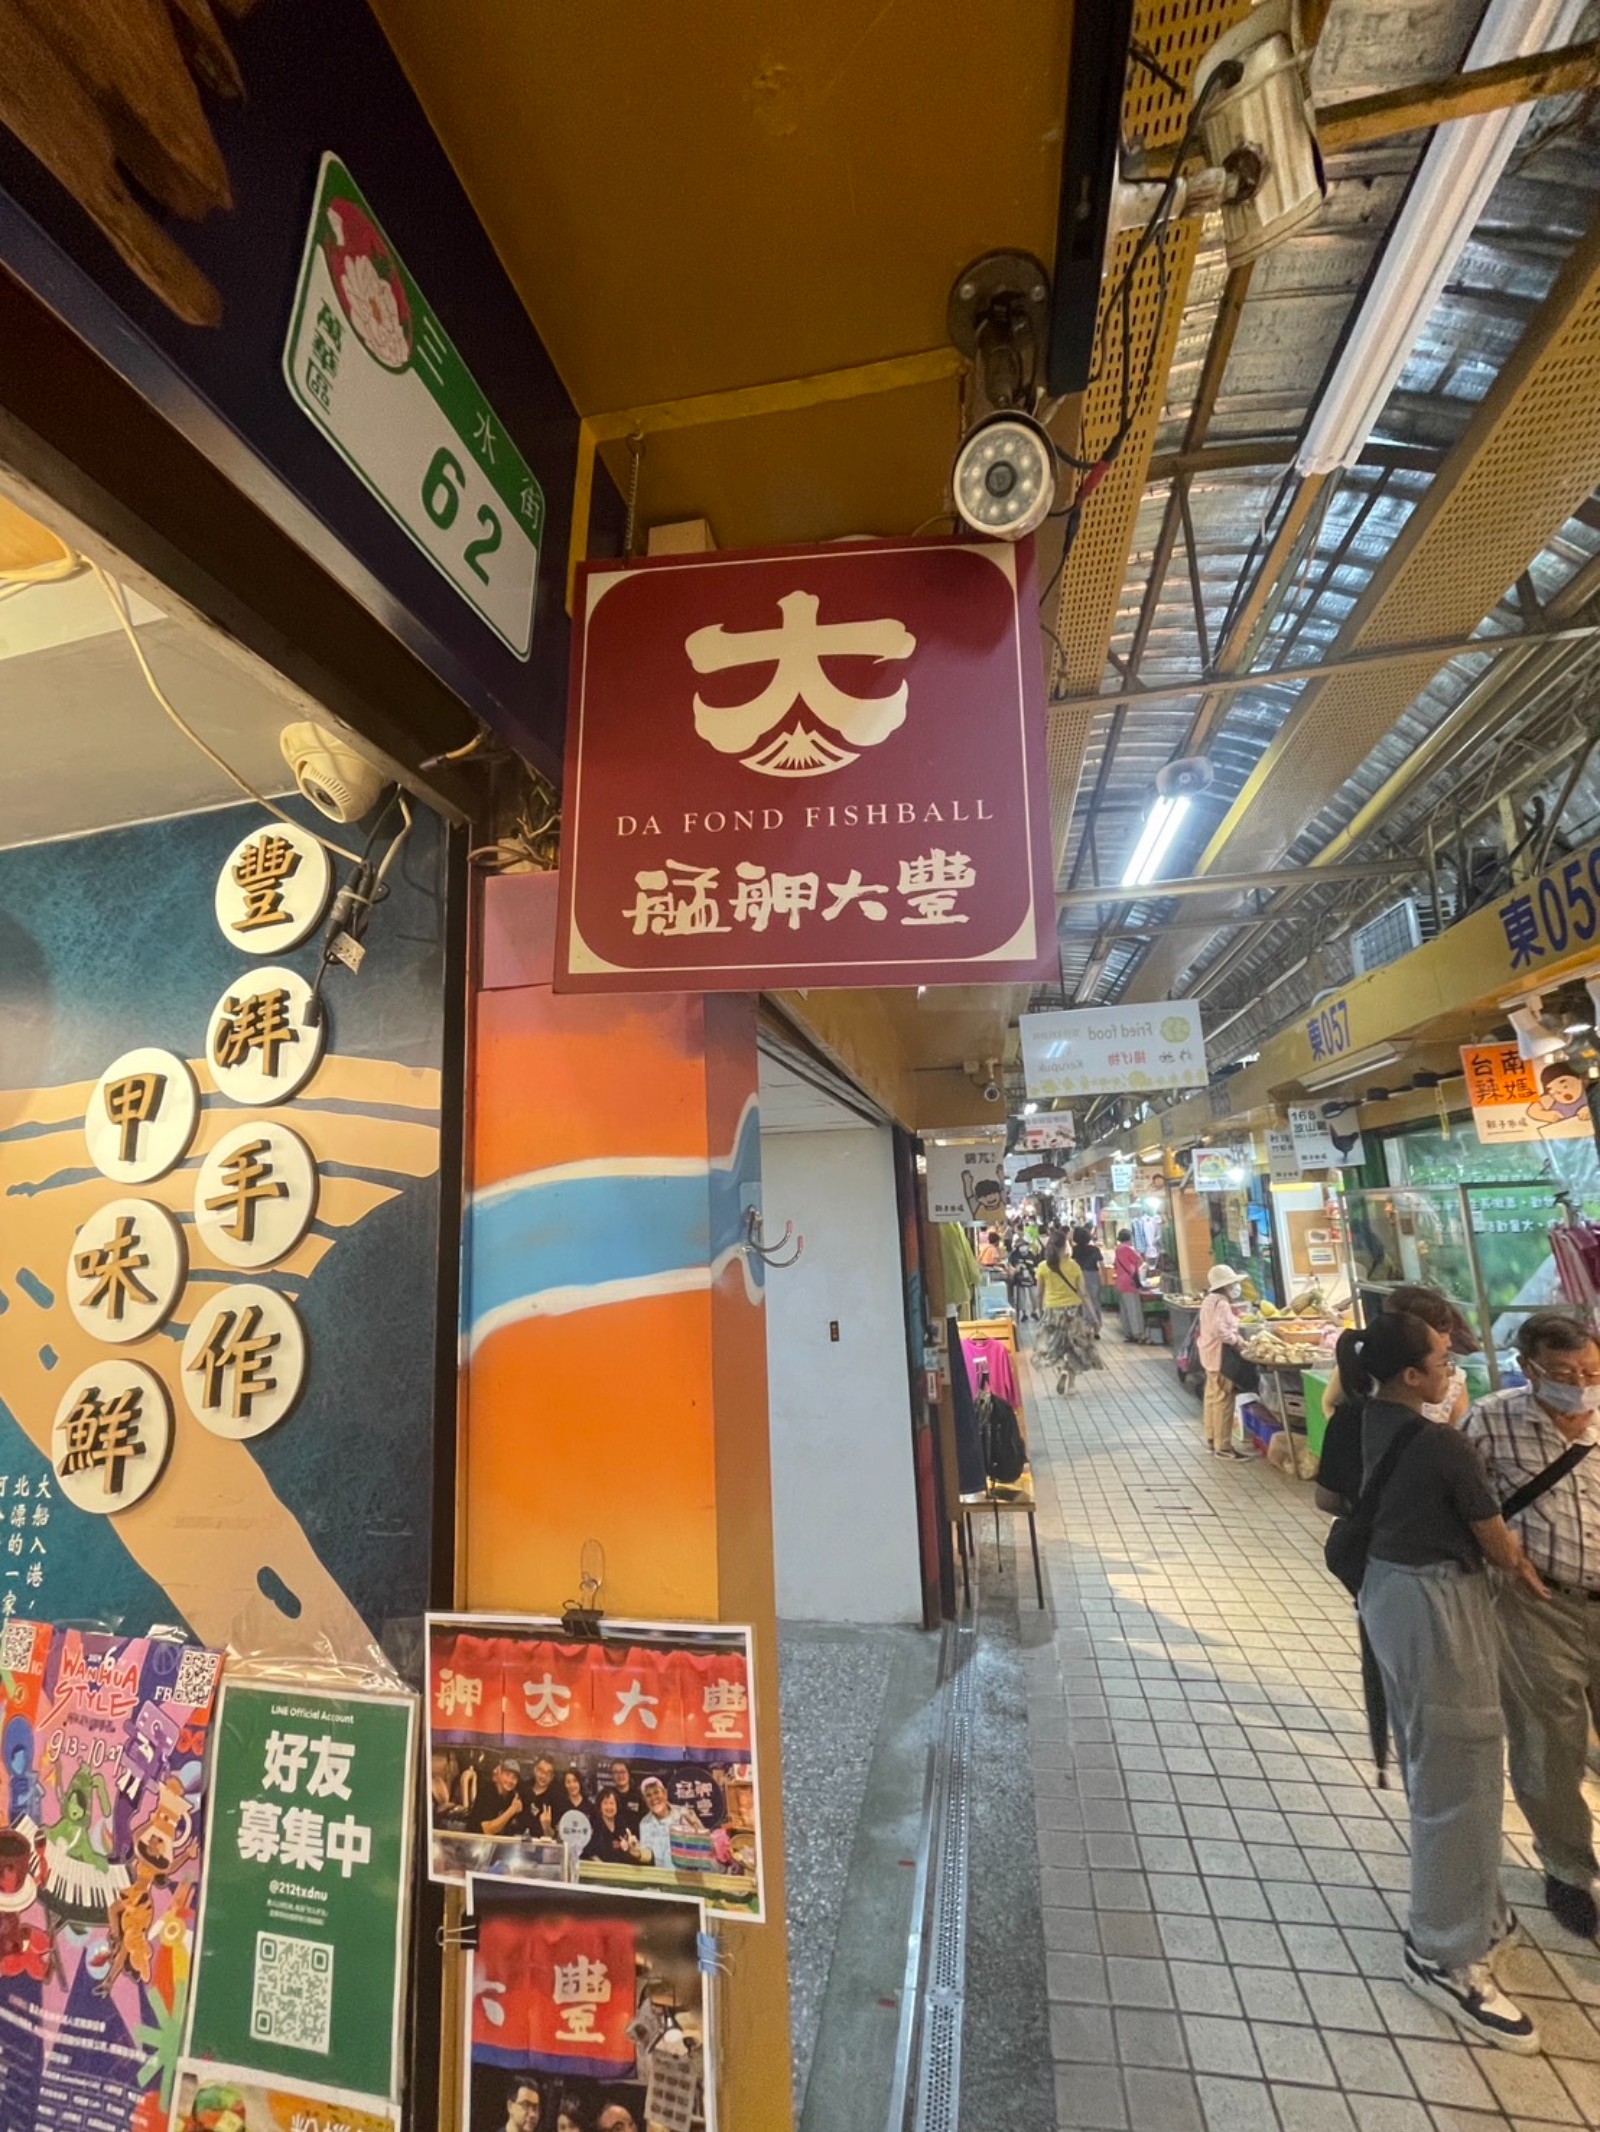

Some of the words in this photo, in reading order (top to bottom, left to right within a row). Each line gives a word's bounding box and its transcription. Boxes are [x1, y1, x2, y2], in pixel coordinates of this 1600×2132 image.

[305, 298, 345, 415] 萬華區
[416, 316, 538, 530] 三水街
[422, 447, 502, 586] 62
[617, 815, 662, 837] DA
[684, 808, 784, 832] FOND
[806, 799, 994, 828] FISHBALL
[622, 848, 976, 937] 艋舺大豐
[1307, 1000, 1351, 1063] 東057
[1471, 1050, 1526, 1077] 台南
[1475, 1077, 1538, 1104] 辣媽
[61, 1648, 140, 1696] WANHUA
[154, 1685, 173, 1701] FB
[36, 1680, 140, 1732] STYLE
[270, 1705, 289, 1717] LINE
[289, 1709, 320, 1721] Official
[320, 1711, 355, 1725] Account
[612, 1680, 659, 1730] 大
[701, 1677, 748, 1741] 豐
[261, 1729, 356, 1801] 好友
[236, 1800, 372, 1878] 募集中
[553, 1953, 612, 2044] 豐
